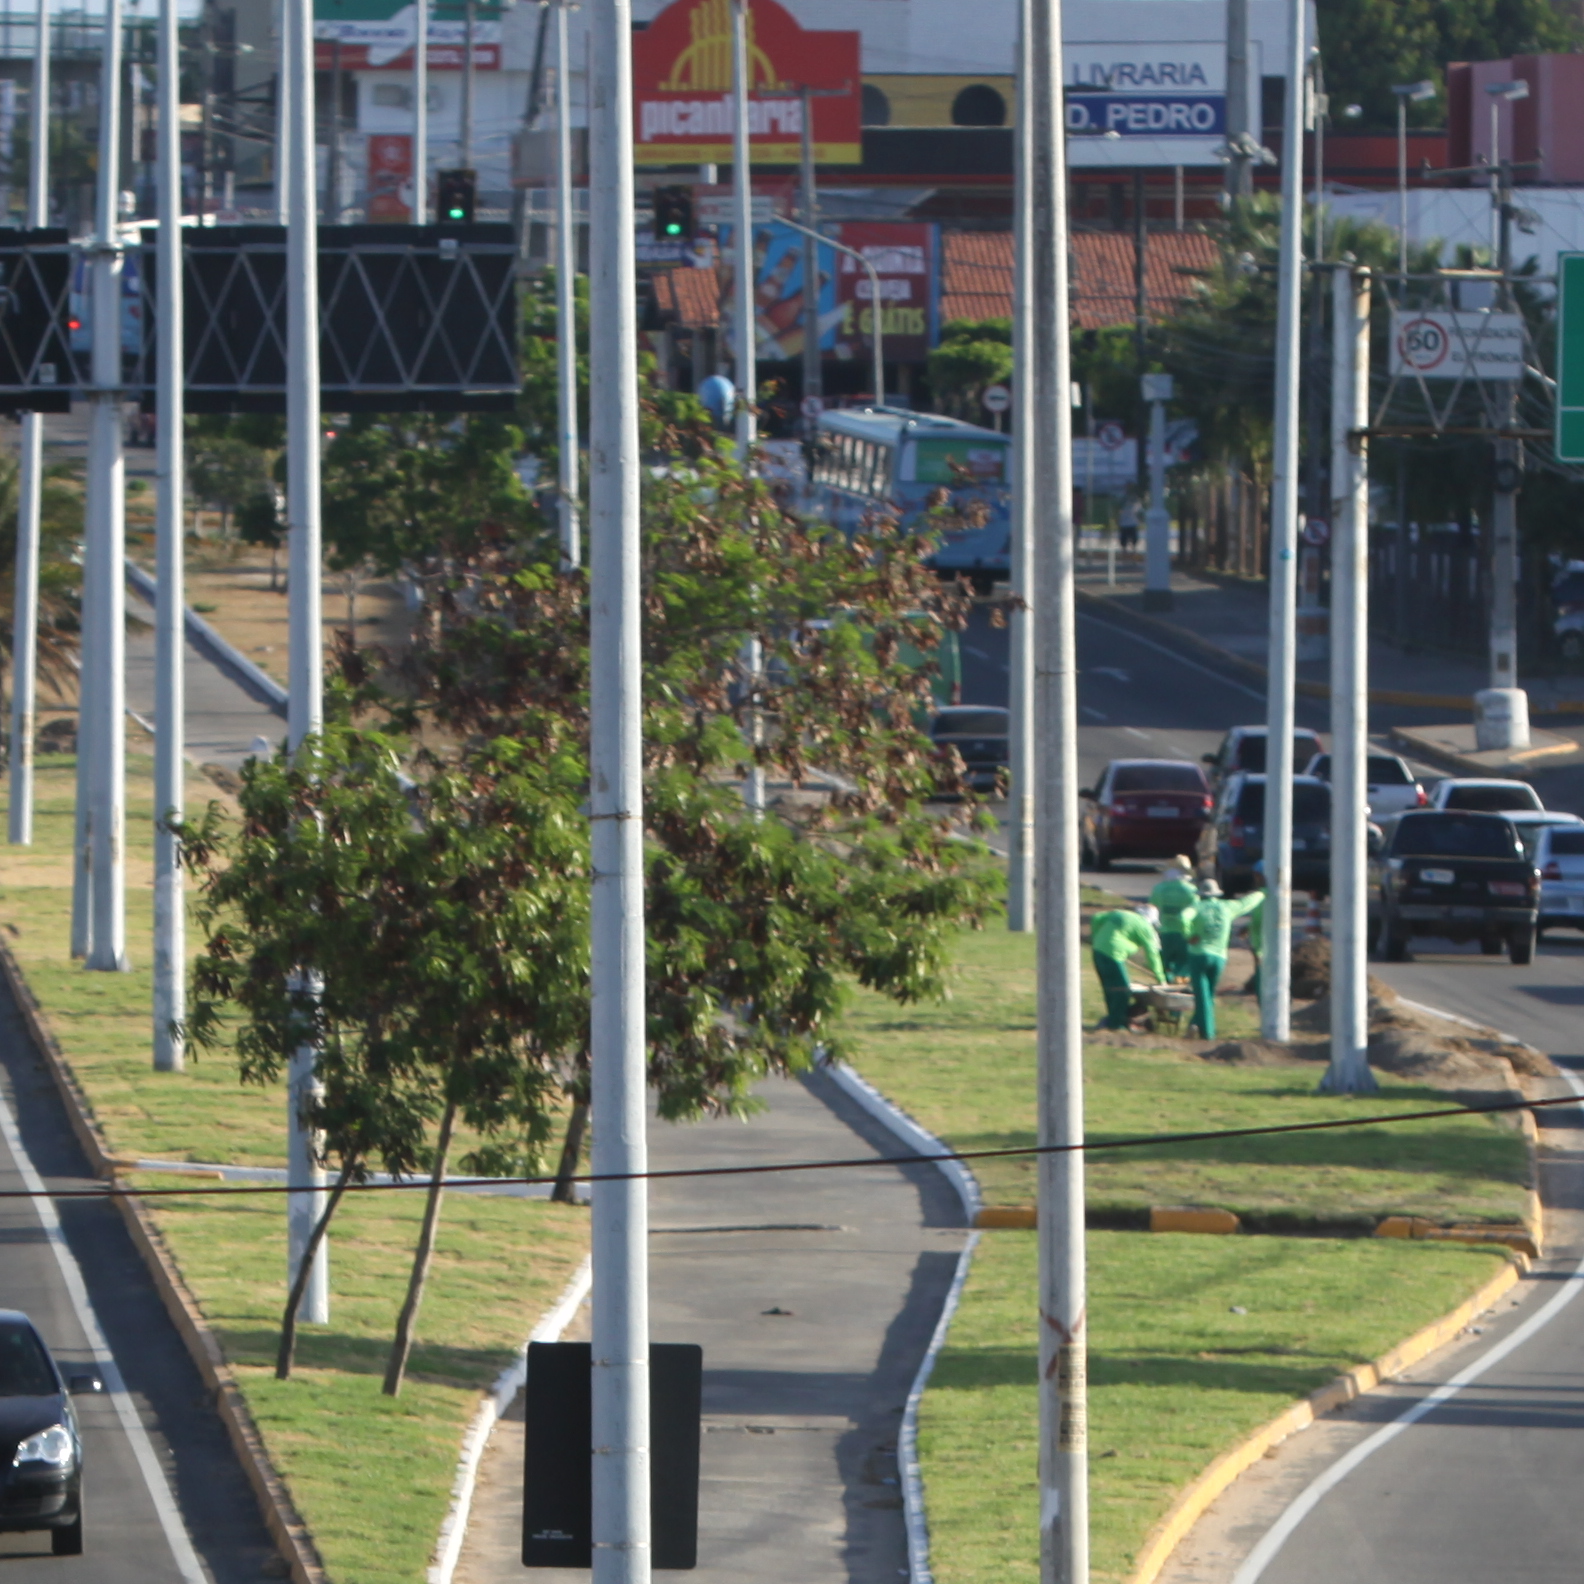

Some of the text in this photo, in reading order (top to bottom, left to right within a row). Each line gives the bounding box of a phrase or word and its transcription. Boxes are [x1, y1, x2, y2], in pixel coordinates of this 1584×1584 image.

[1071, 62, 1207, 86] LIVRARIA
[1066, 102, 1216, 131] D. PEDRO
